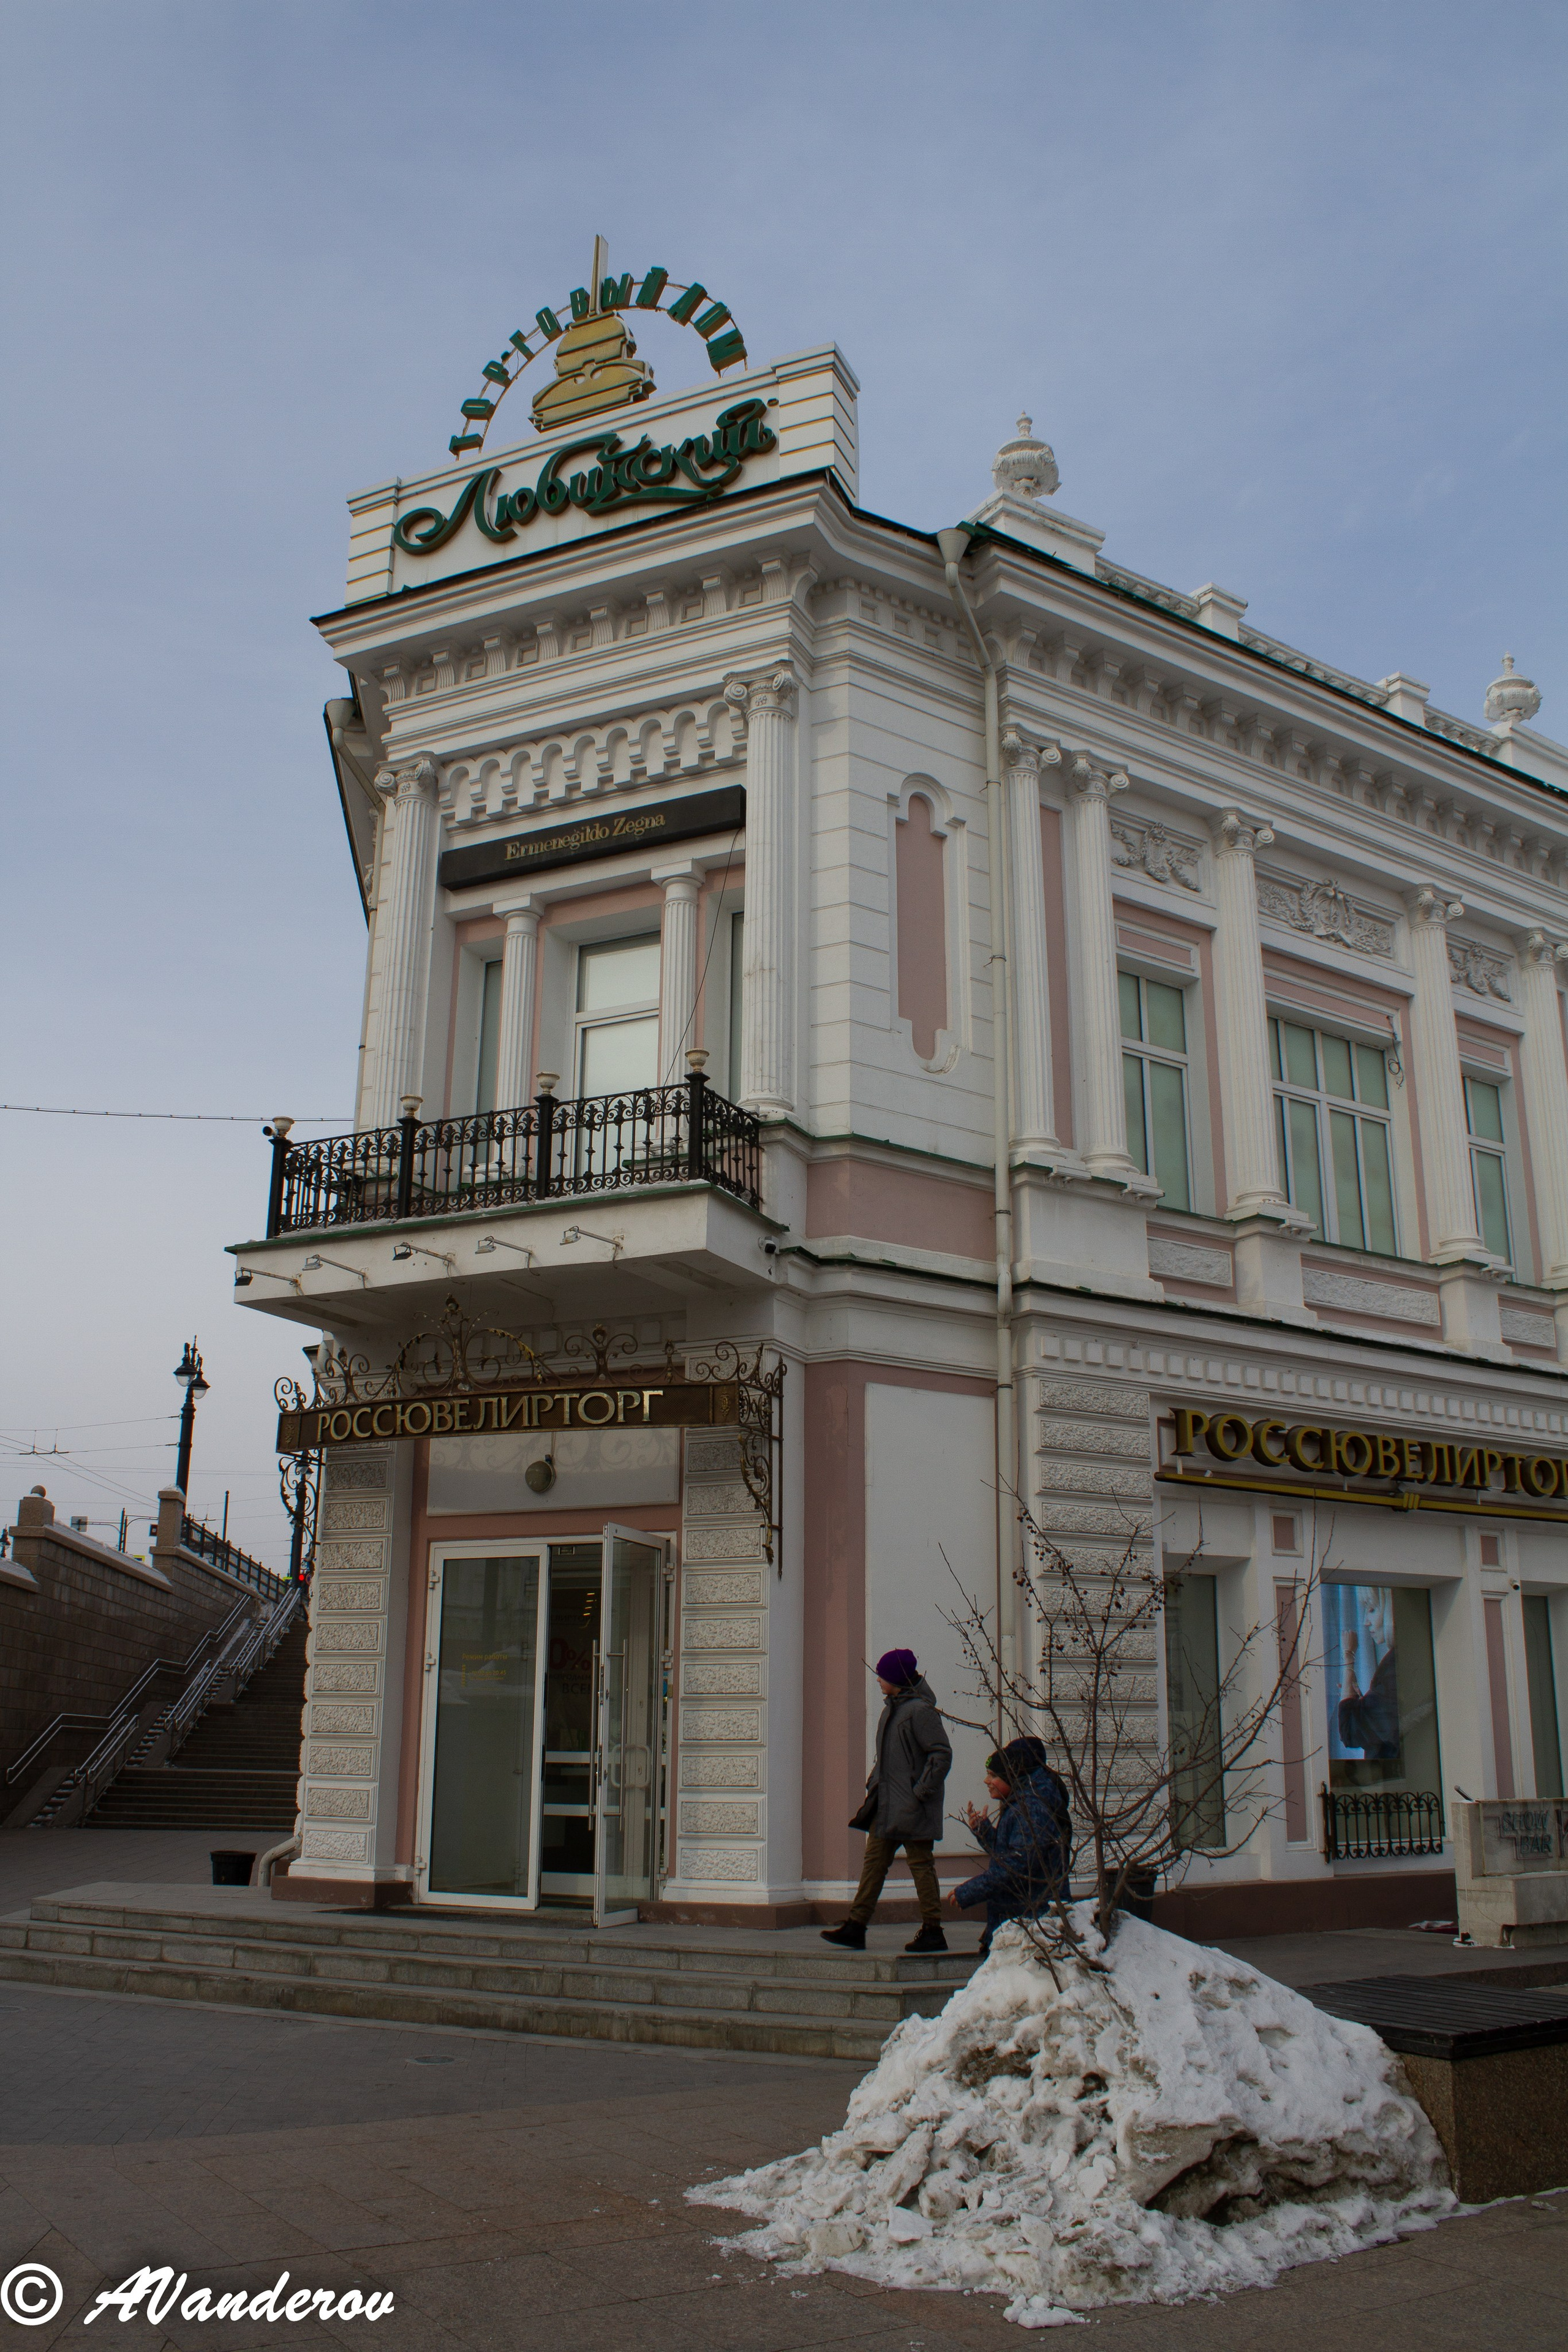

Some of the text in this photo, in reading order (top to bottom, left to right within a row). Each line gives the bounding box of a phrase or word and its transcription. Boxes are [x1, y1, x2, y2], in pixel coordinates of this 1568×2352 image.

[449, 266, 748, 456] ТОРГОВЫЙ ДОМ
[394, 398, 779, 556] Любинский
[505, 814, 666, 860] Ermenegildo Zegna
[316, 1389, 664, 1442] РОССЮВЕЛИРТОРГ
[549, 1637, 591, 1670] 0%
[1502, 1811, 1548, 1831] SHOW
[1520, 1834, 1552, 1853] BAR
